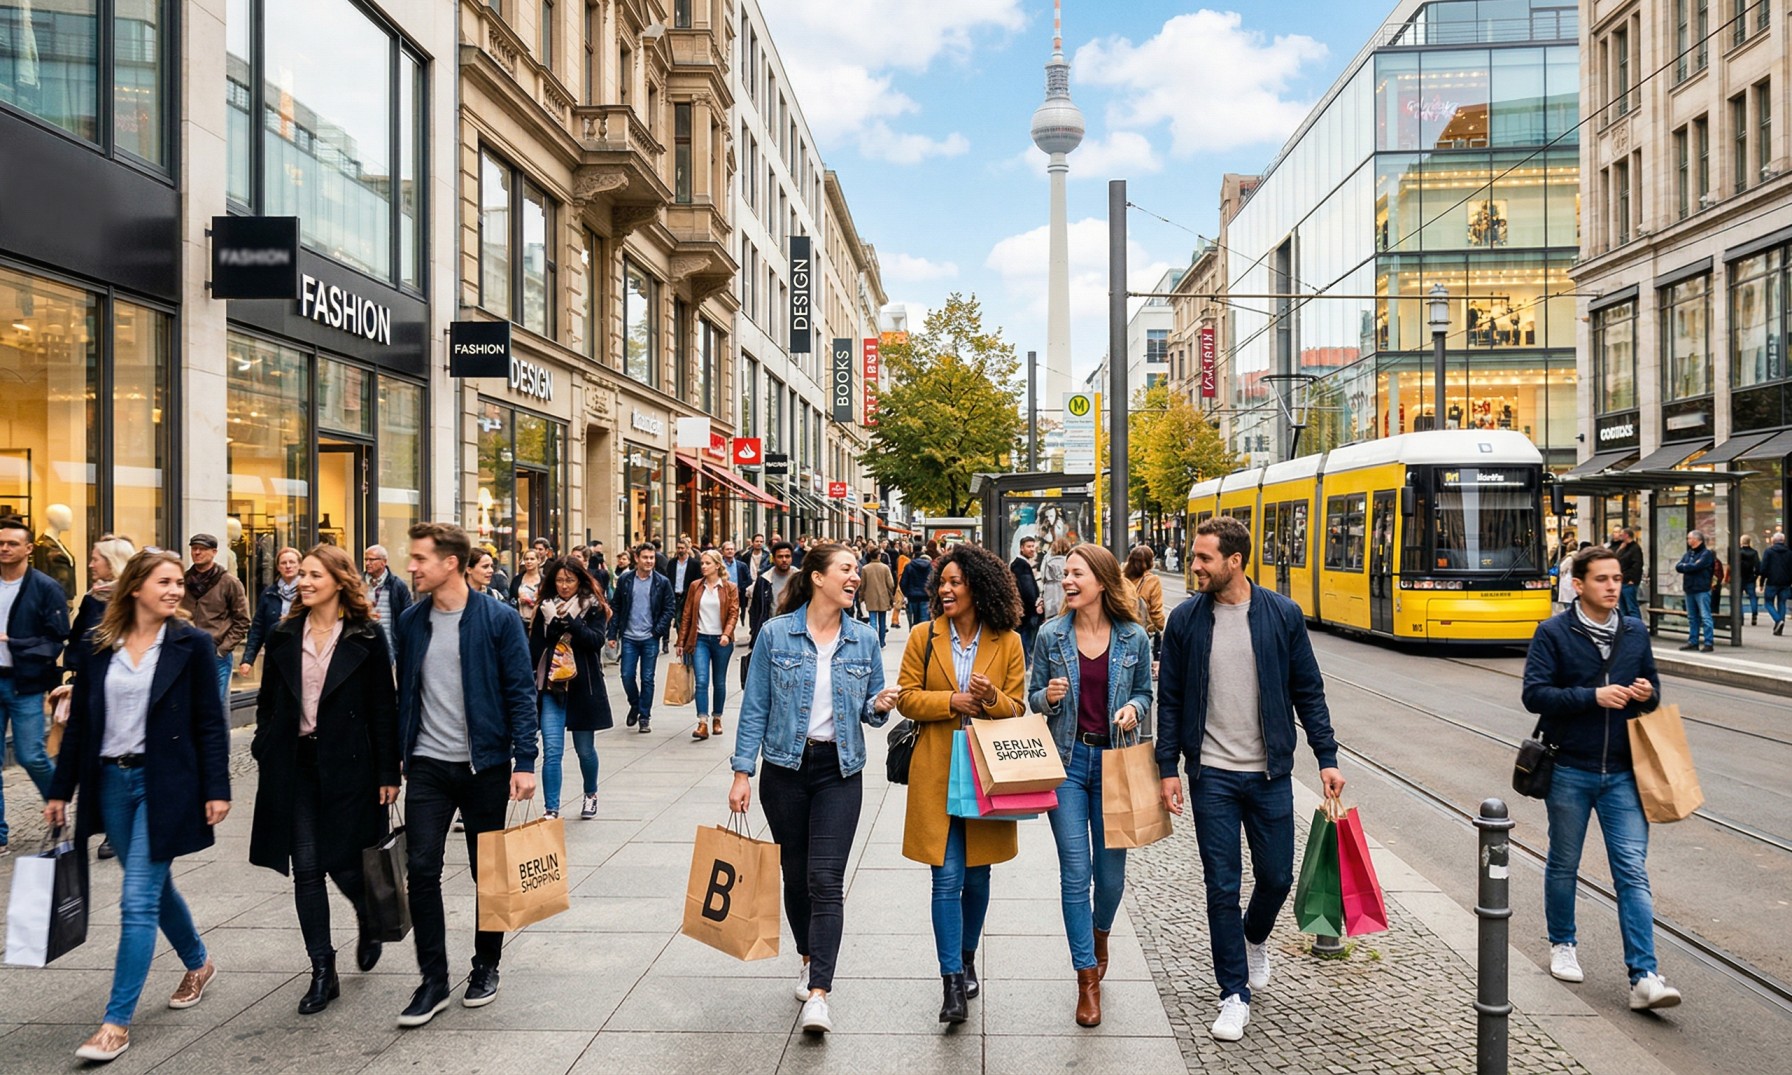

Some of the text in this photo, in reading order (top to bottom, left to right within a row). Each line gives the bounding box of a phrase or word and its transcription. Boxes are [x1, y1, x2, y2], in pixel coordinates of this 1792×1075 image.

[793, 260, 808, 330] DESIGN
[301, 273, 391, 345] FASHION
[454, 344, 505, 355] FASHION
[510, 356, 554, 402] DESIGN
[836, 350, 850, 406] BOOKS
[1074, 399, 1084, 412] M
[992, 738, 1044, 751] BERLIN
[996, 749, 1047, 761] SHOPPING
[518, 852, 559, 880] BERLIN
[520, 869, 561, 893] SHOPPING
